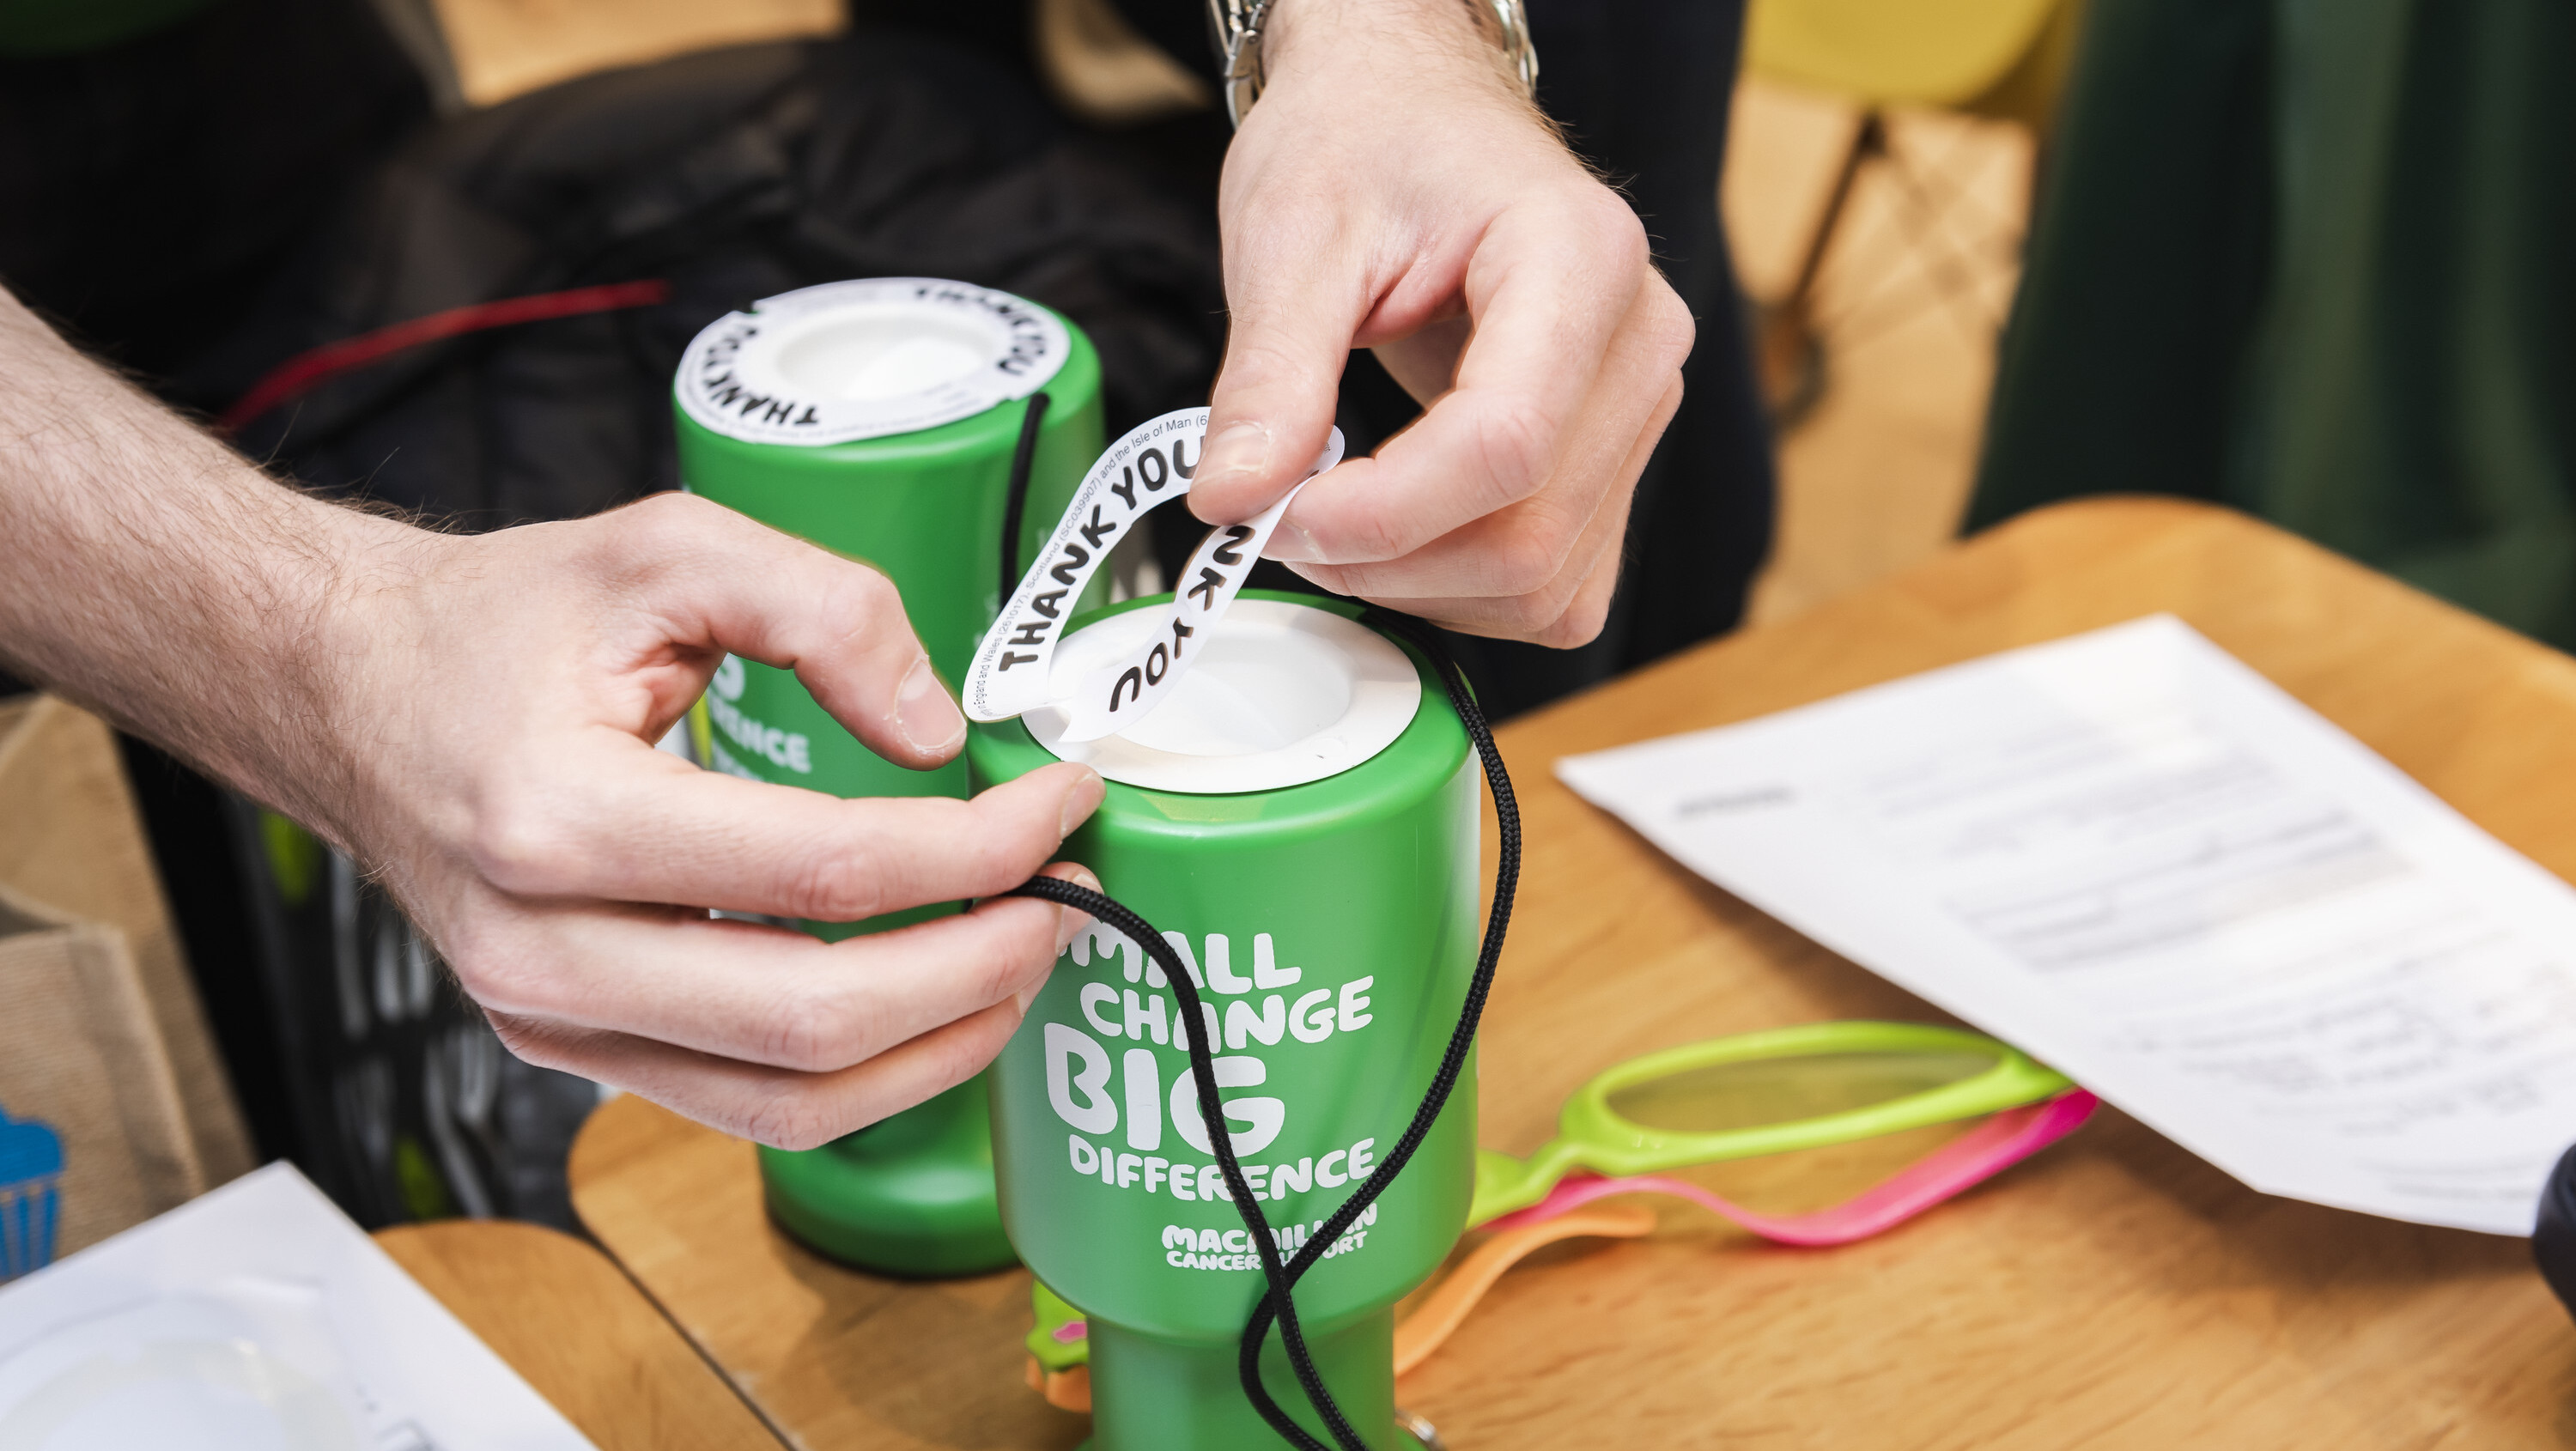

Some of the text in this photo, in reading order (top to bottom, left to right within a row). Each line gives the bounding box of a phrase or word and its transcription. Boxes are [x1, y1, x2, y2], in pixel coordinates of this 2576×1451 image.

[702, 369, 820, 426] THANK
[981, 637, 1003, 663] Wales
[1025, 542, 1060, 589] Scotland
[1059, 476, 1103, 541] (SC039907)
[1101, 458, 1116, 479] and
[1115, 445, 1131, 462] the
[1131, 432, 1151, 449] Isle
[1152, 423, 1163, 438] of
[1165, 417, 1192, 433] Man
[998, 435, 1206, 672] THANK YOU
[1109, 616, 1194, 713] YOU
[1059, 916, 1303, 995] MALL
[1079, 974, 1375, 1054] CHANGE
[1043, 1022, 1286, 1158] BIG
[1068, 1137, 1376, 1202] DIFFERENCE
[1161, 1202, 1378, 1254] MACILN
[1165, 1230, 1369, 1272] CANCER UORT
